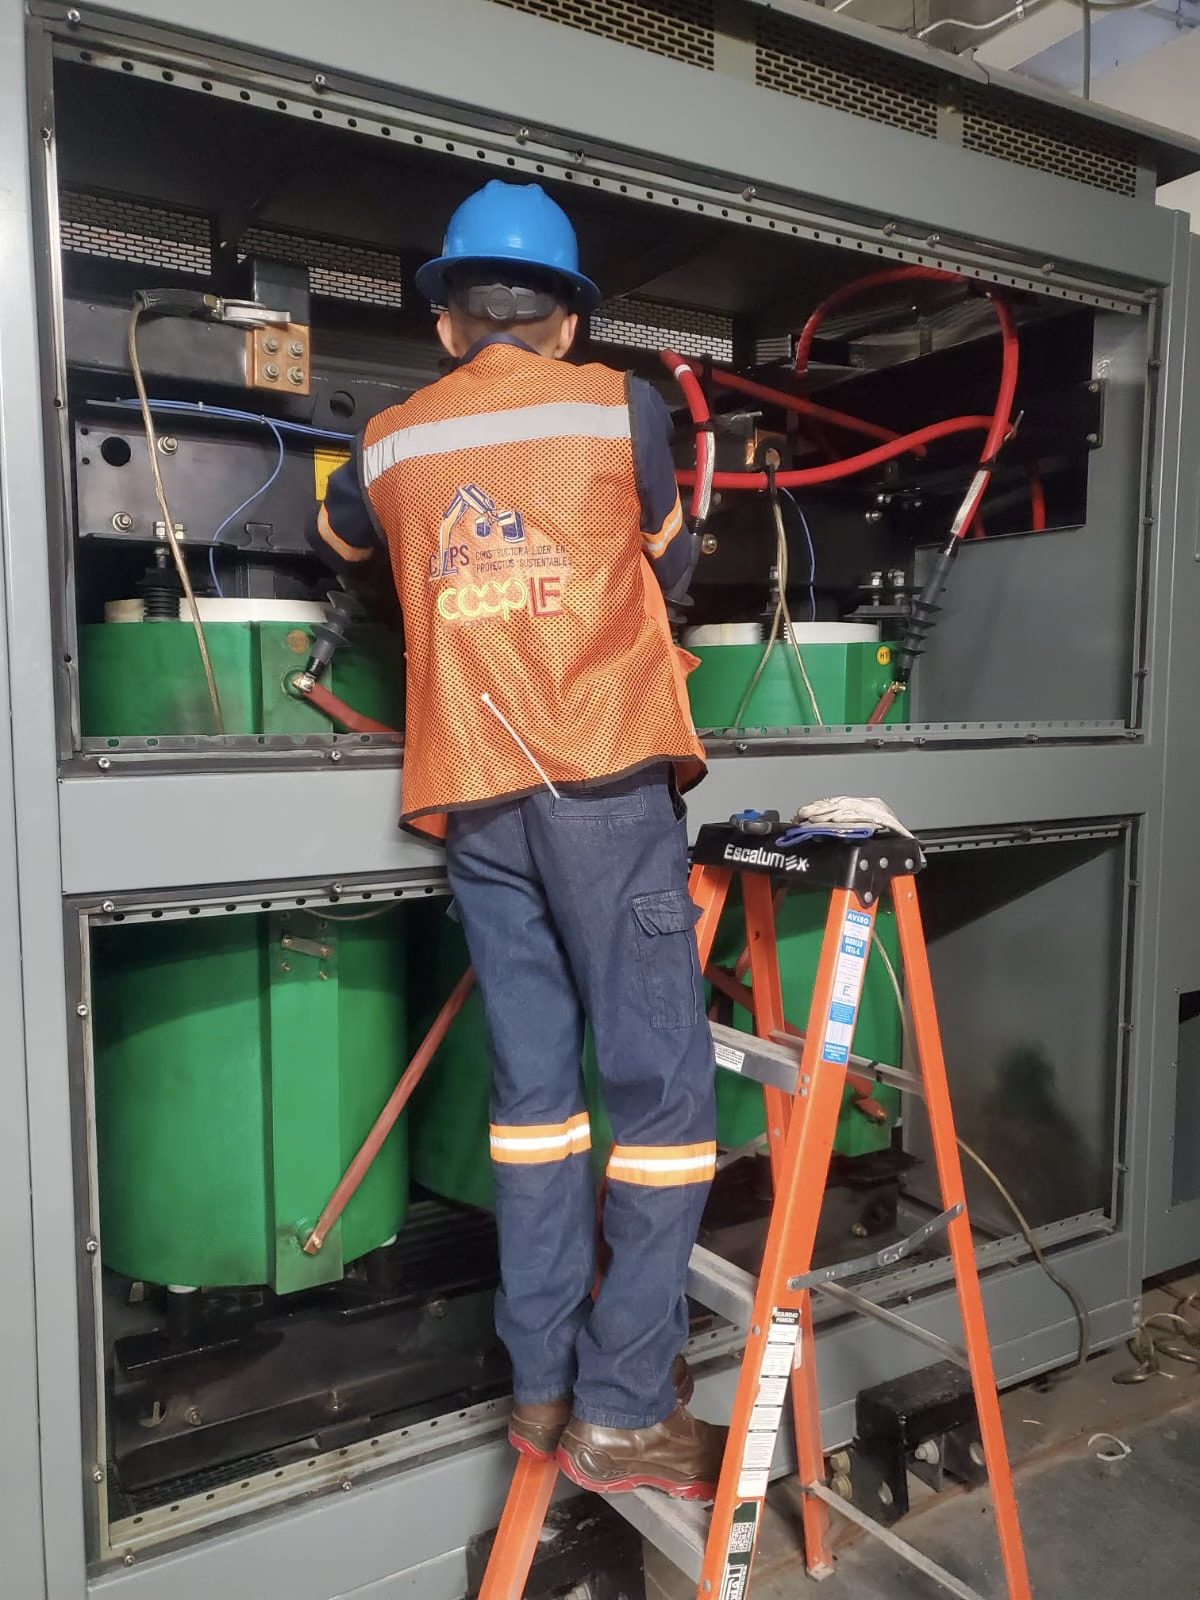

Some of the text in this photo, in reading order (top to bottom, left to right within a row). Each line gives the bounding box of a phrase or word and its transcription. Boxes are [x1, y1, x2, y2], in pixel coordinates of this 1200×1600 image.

[475, 546, 528, 561] CONSTRUCTORA
[555, 544, 567, 554] EN
[476, 559, 515, 573] PROYECTOS
[847, 911, 869, 925] AVISO
